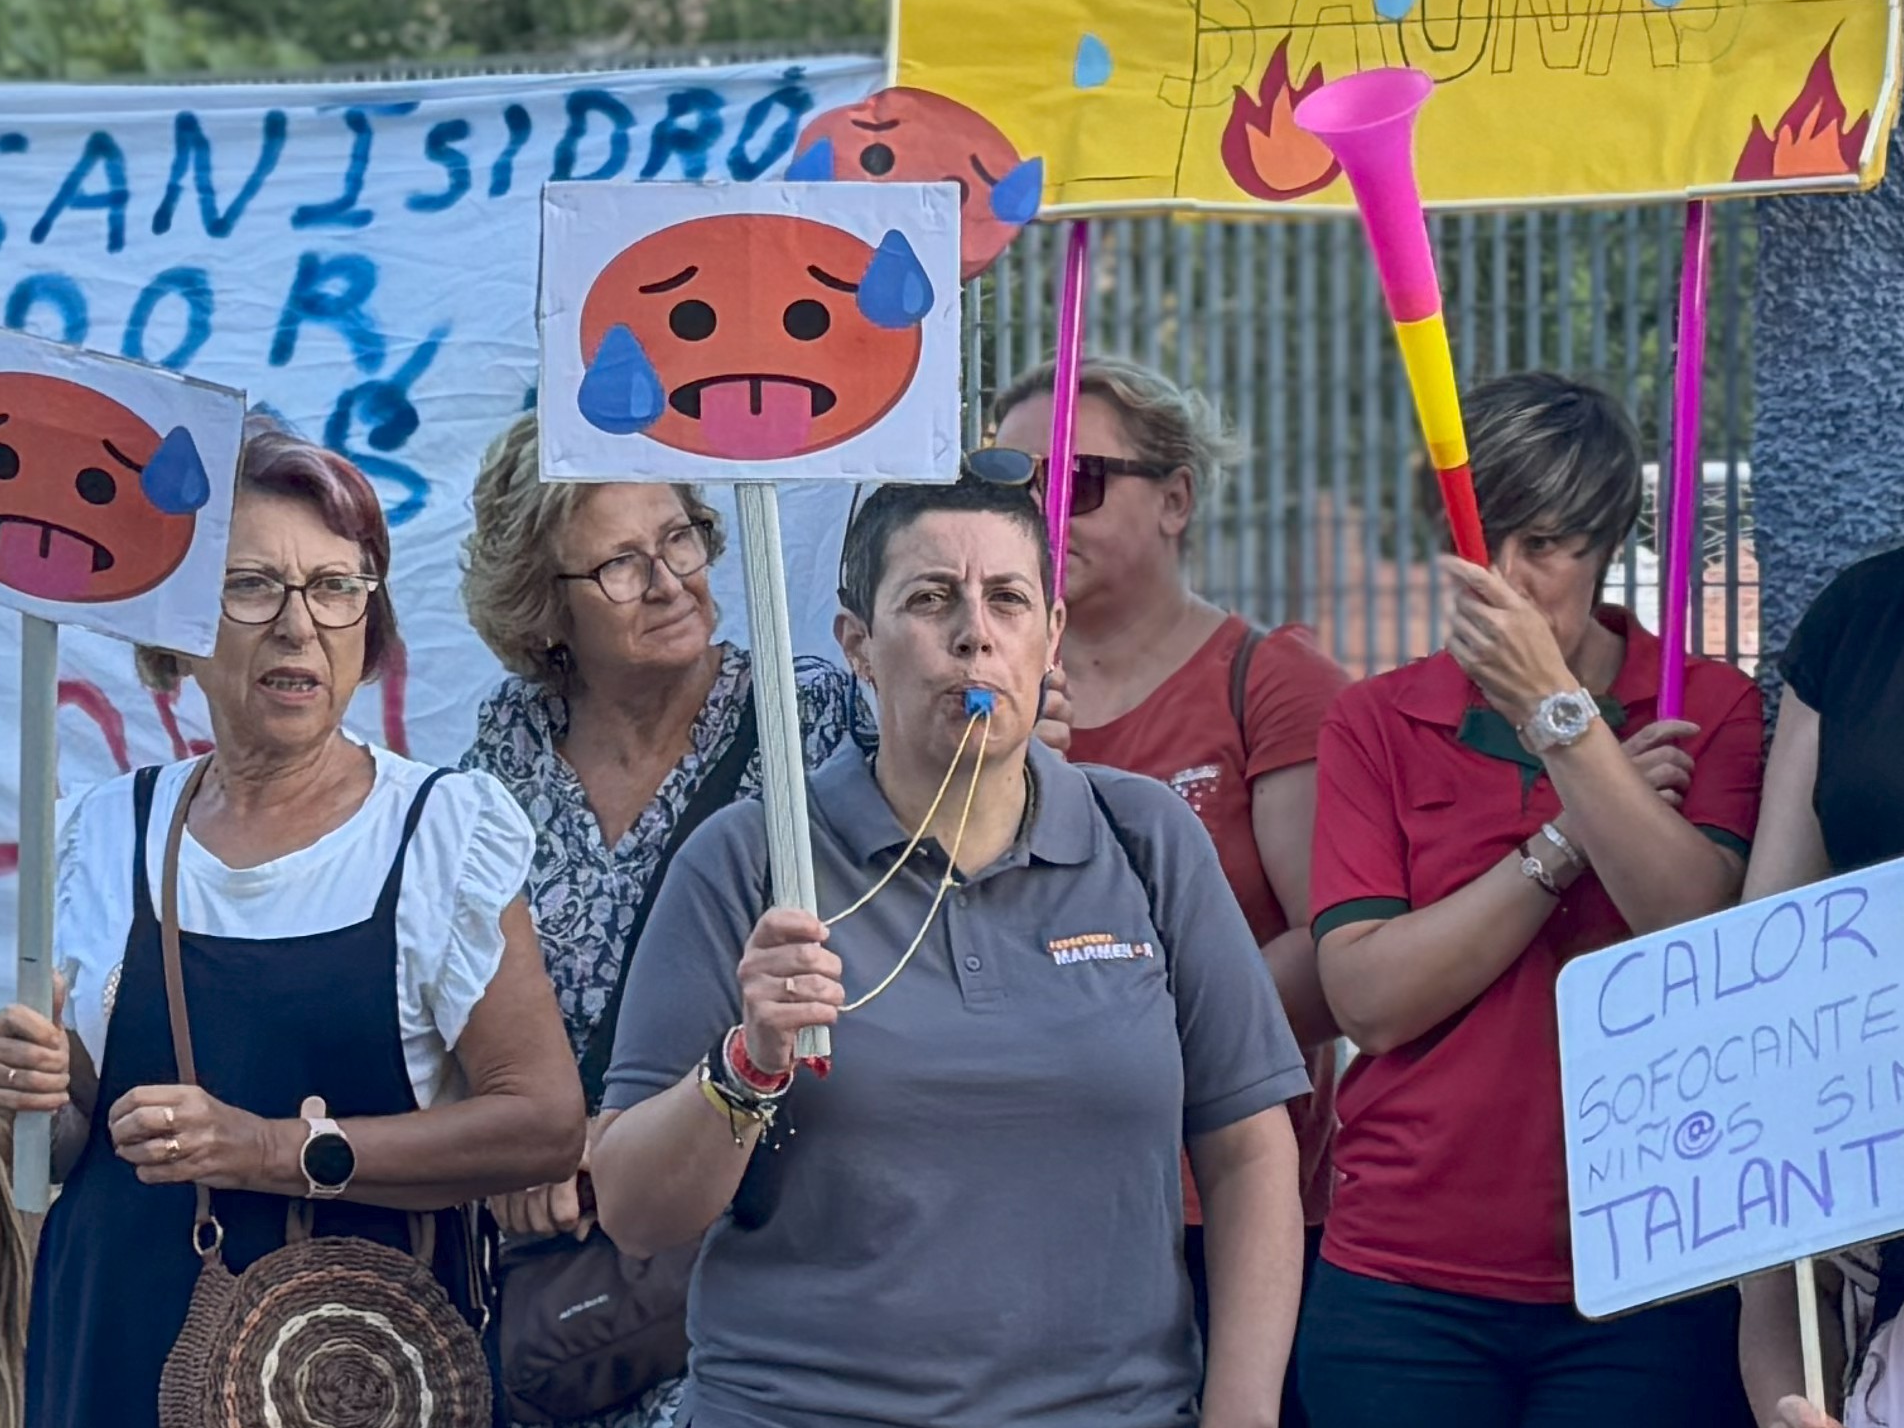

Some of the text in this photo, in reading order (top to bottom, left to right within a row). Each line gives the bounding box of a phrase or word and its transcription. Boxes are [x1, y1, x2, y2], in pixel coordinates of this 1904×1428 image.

[1597, 886, 1878, 1039] CALOR
[1578, 982, 1901, 1145] SOFOCANTE
[1586, 1101, 1764, 1193] NIÑ@S
